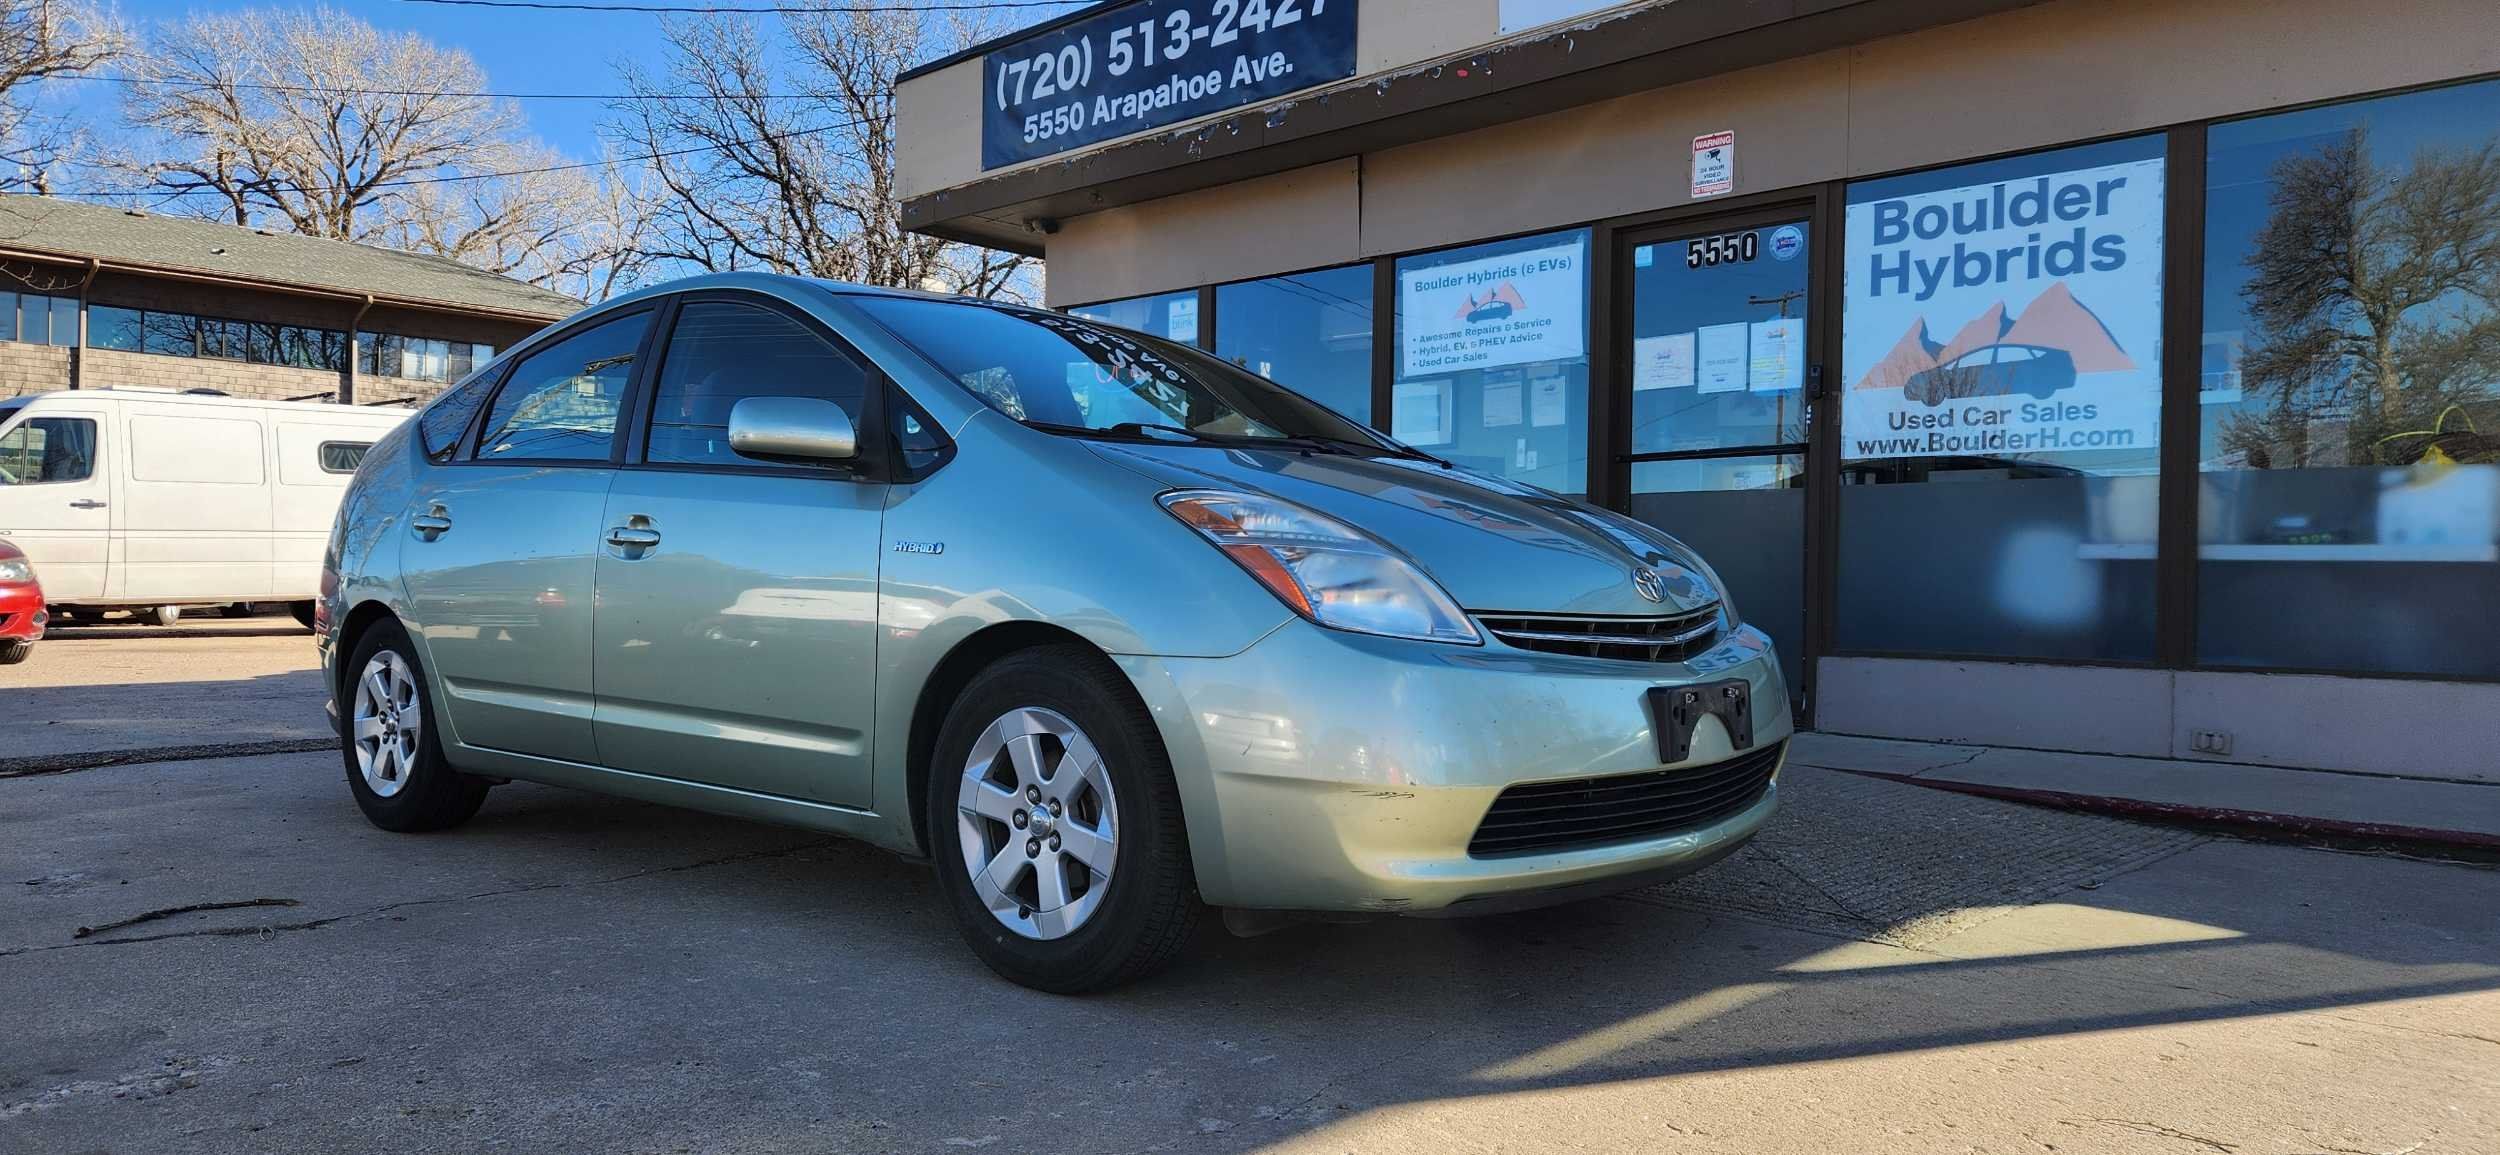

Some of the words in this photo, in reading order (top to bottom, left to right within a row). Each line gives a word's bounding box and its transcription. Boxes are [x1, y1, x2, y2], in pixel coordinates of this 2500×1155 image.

[997, 35, 1093, 111] (720)
[1024, 102, 1085, 143] 5550
[1092, 71, 1222, 126] Arapahoe
[1230, 52, 1293, 88] Ave.
[1695, 135, 1731, 150] WARNING
[1873, 176, 2128, 247] Boulder
[1688, 232, 1759, 268] 5550
[1870, 226, 2127, 301] Hybrids
[1415, 275, 1464, 292] Boulder
[1467, 266, 1517, 284] Hybrids
[1538, 256, 1572, 272] EVs)
[1419, 331, 1462, 343] Awesome
[1465, 324, 1502, 337] Repairs
[1513, 317, 1552, 330] Service
[1479, 336, 1507, 348] PHEV
[1509, 331, 1543, 344] Advice
[1419, 357, 1442, 367] Used
[1445, 354, 1461, 364] Car
[1463, 351, 1488, 362] Sales
[1889, 407, 1954, 431] Used
[1963, 406, 2012, 427] Car
[2021, 401, 2098, 423] Sales
[1856, 428, 2134, 456] www.BoulderH.com
[893, 541, 935, 554] HYBRID
